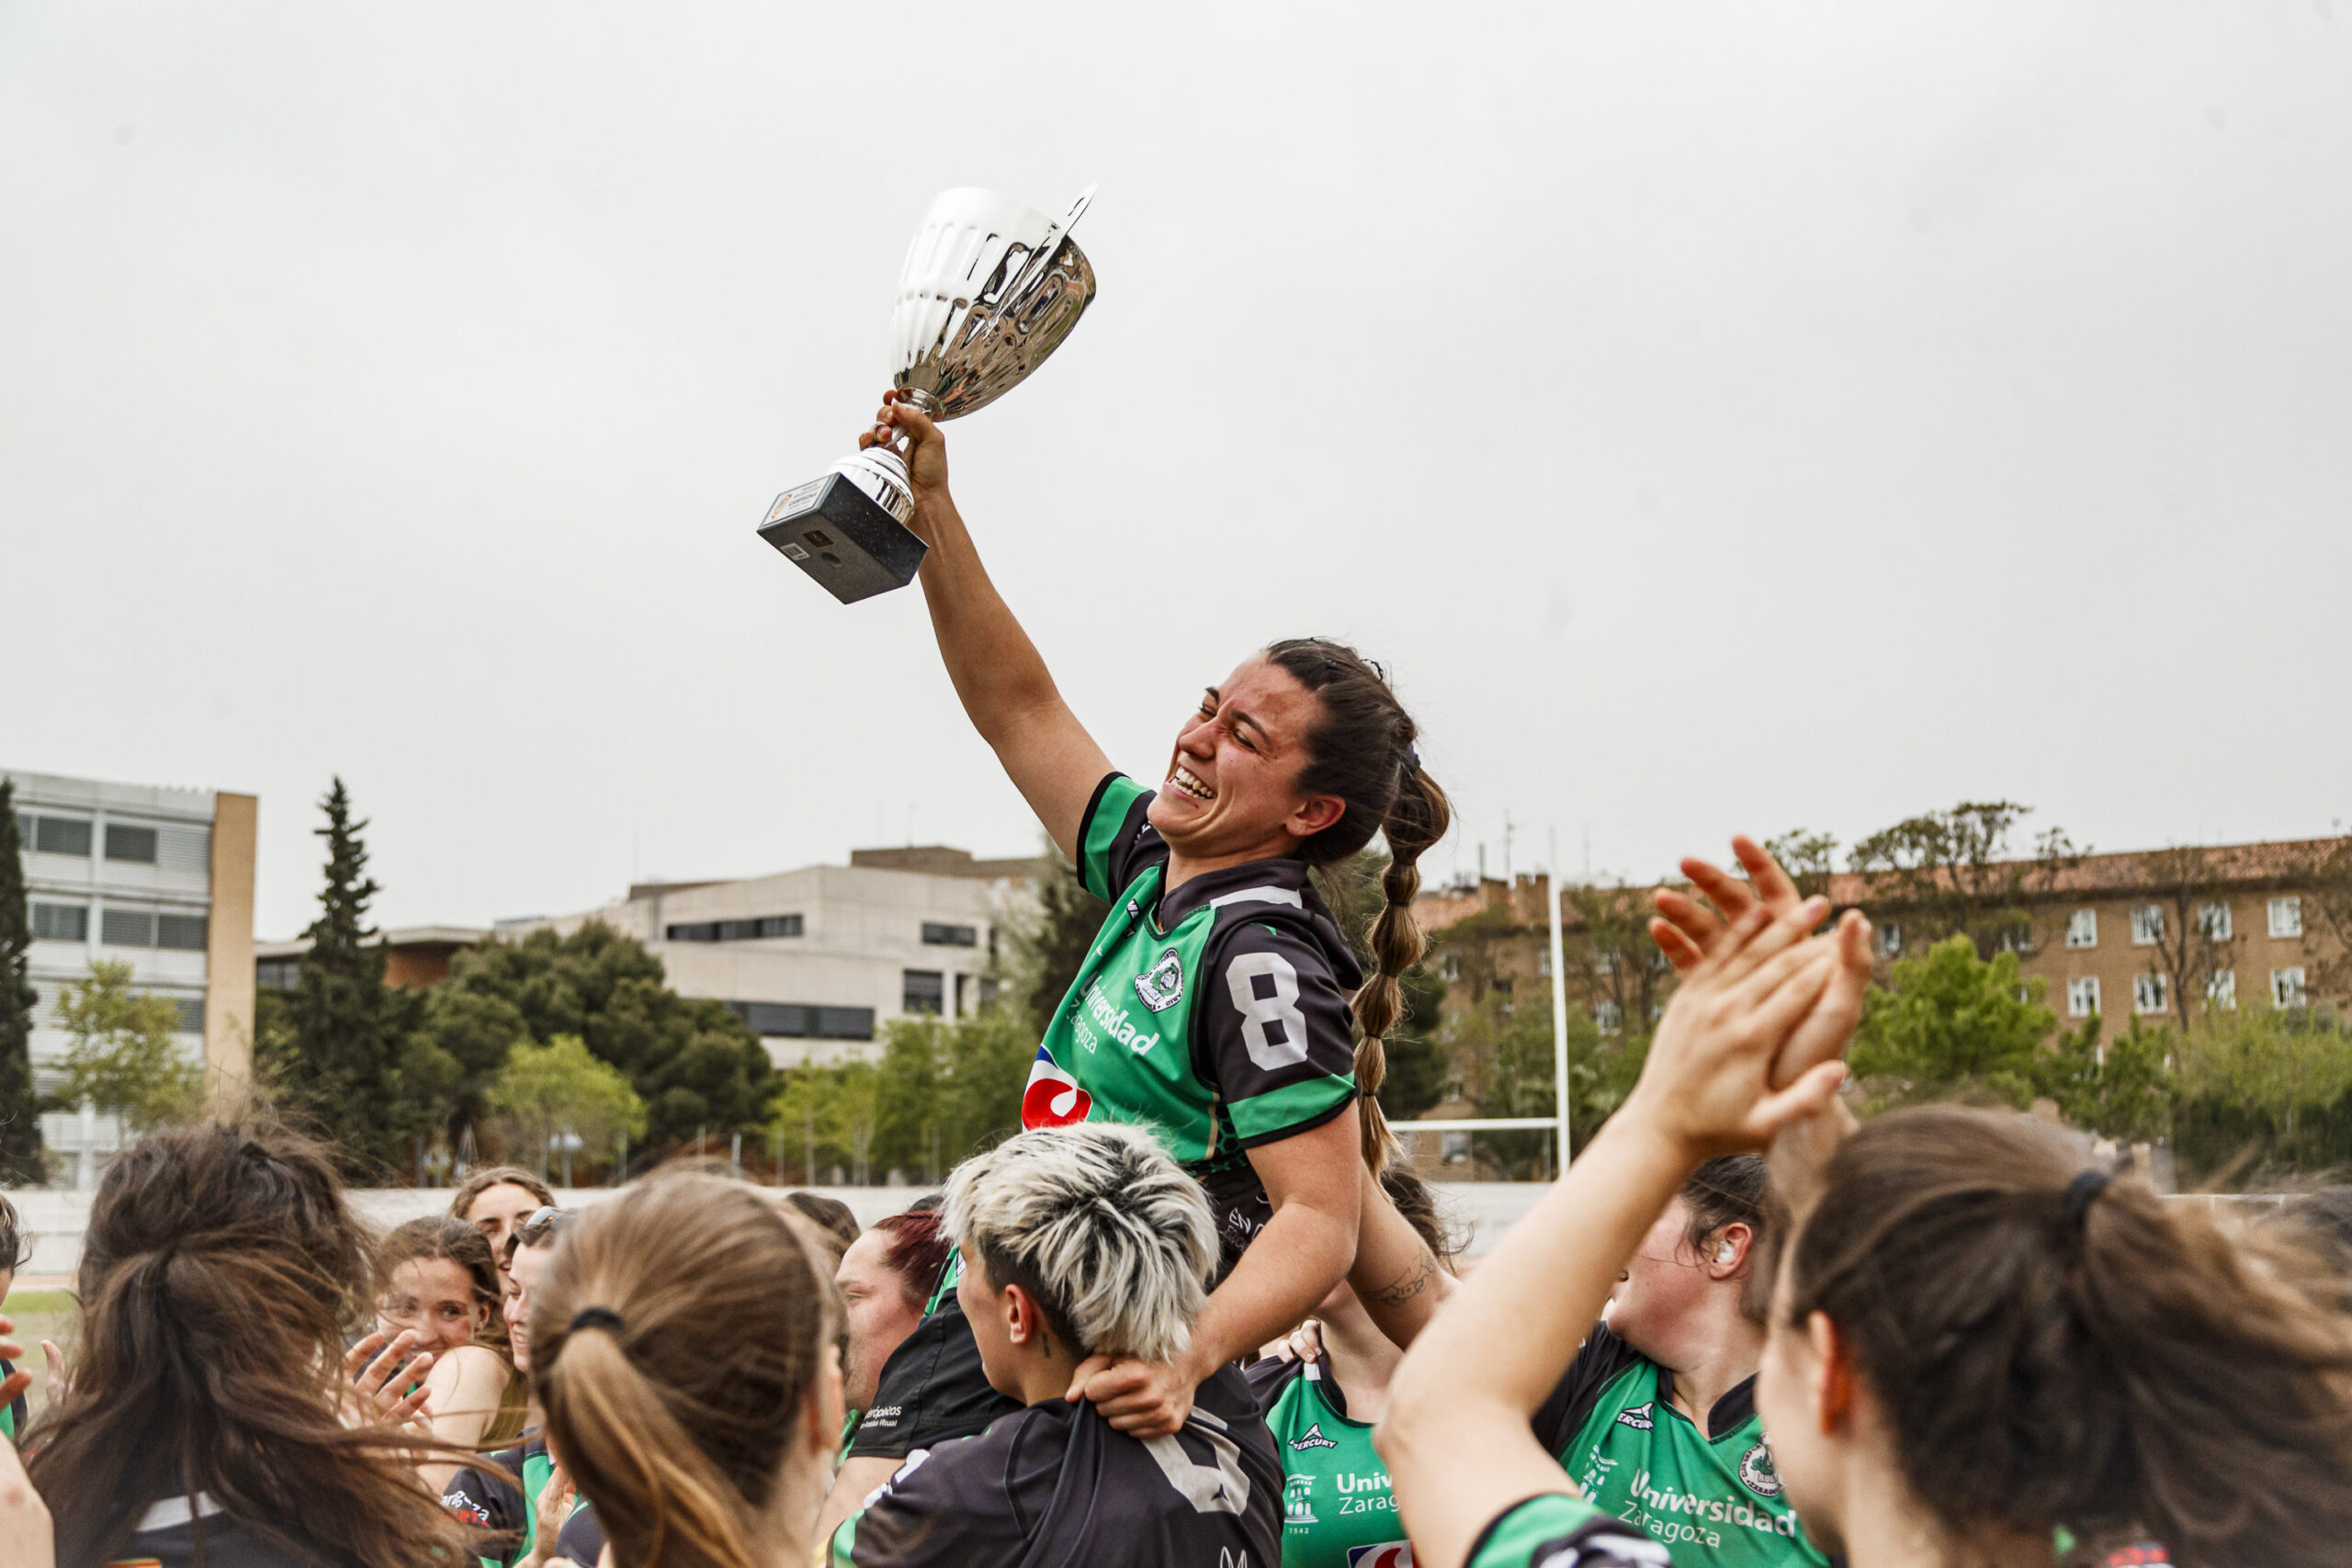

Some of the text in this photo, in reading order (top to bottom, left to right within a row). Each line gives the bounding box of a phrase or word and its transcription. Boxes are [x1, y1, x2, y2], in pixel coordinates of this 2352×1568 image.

[1080, 970, 1160, 1056] Universidad
[1226, 952, 1308, 1072] 8
[1337, 1472, 1393, 1494] Univ
[1339, 1495, 1401, 1515] Zarag
[1630, 1469, 1797, 1538] Universidad
[1620, 1500, 1721, 1549] Zaragoza
